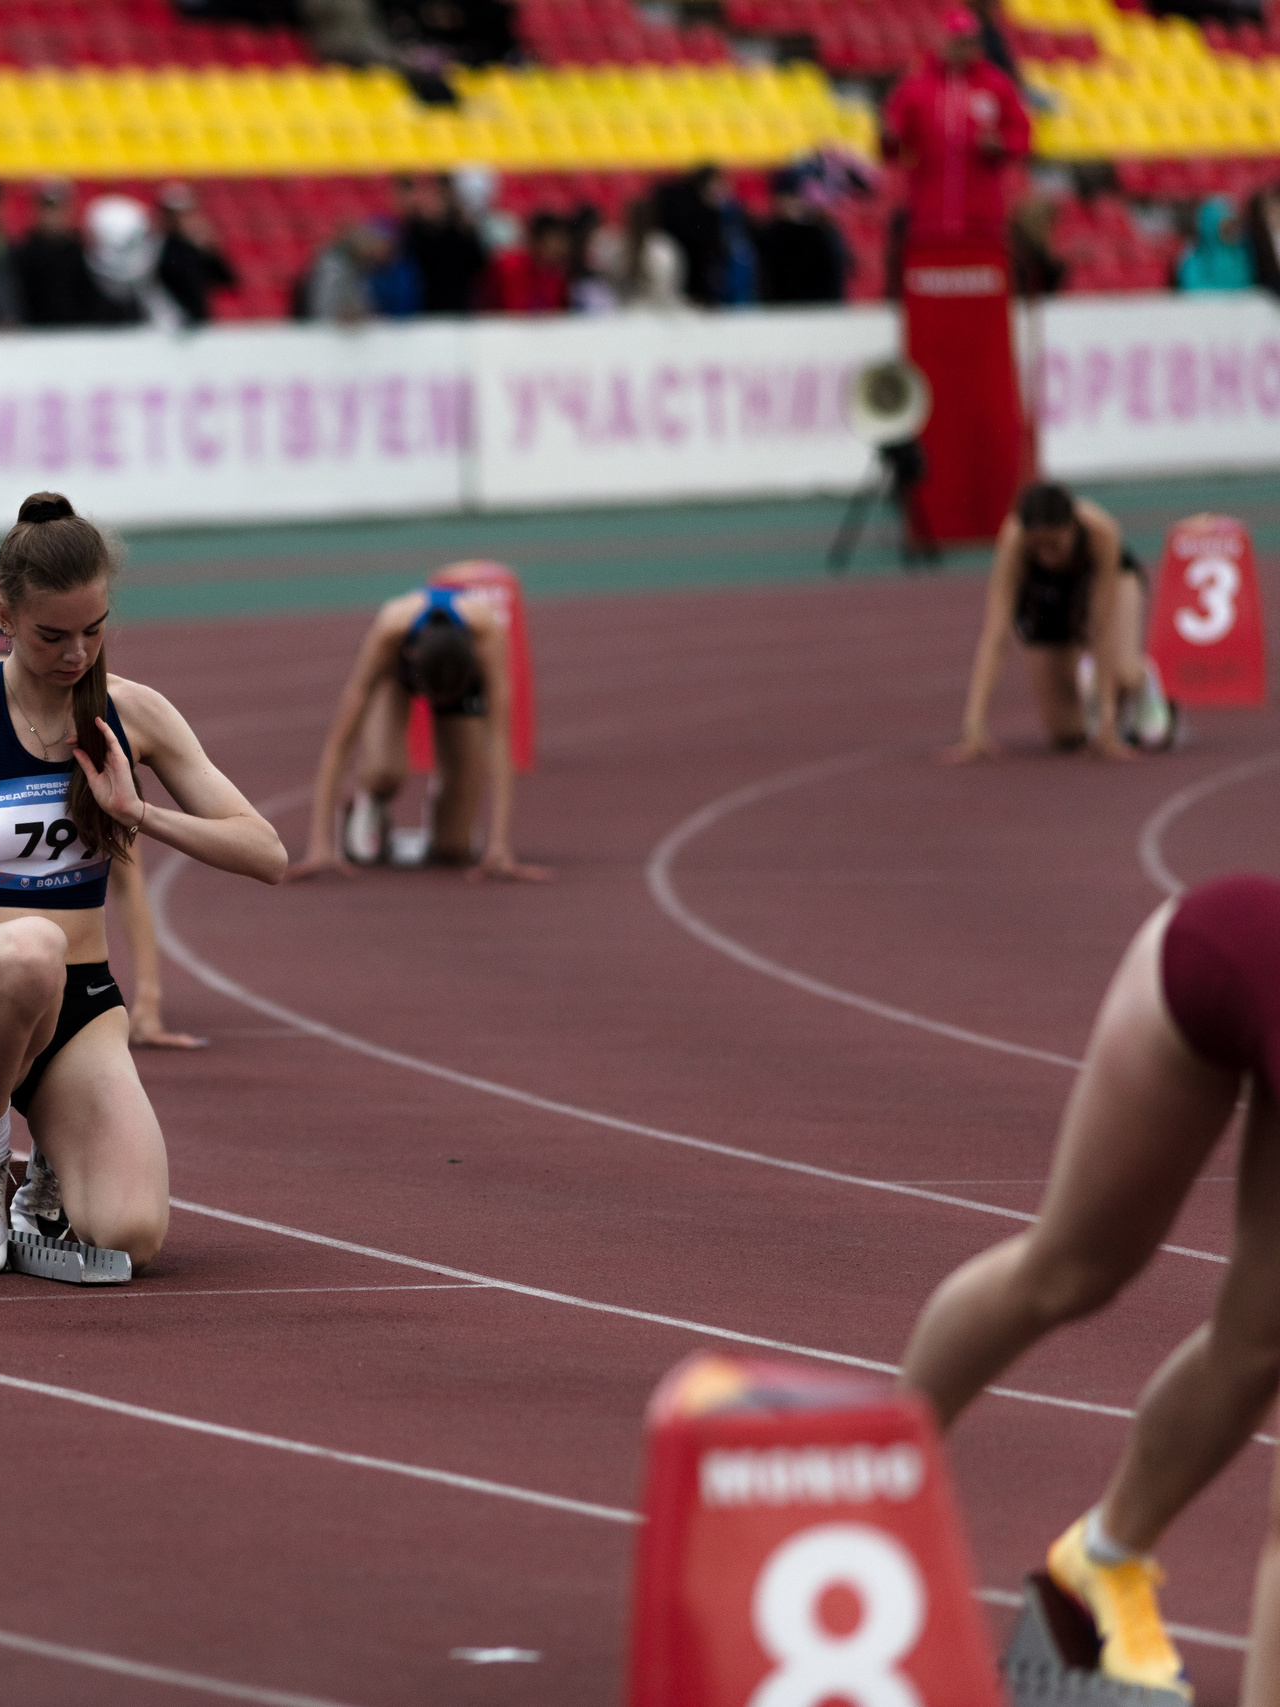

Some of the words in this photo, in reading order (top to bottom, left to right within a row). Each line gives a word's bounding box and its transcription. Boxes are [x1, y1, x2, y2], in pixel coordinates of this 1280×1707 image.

[1173, 557, 1242, 647] 3
[14, 818, 100, 861] 79
[36, 875, 70, 888] ВФЛА
[745, 1520, 929, 1707] 8
